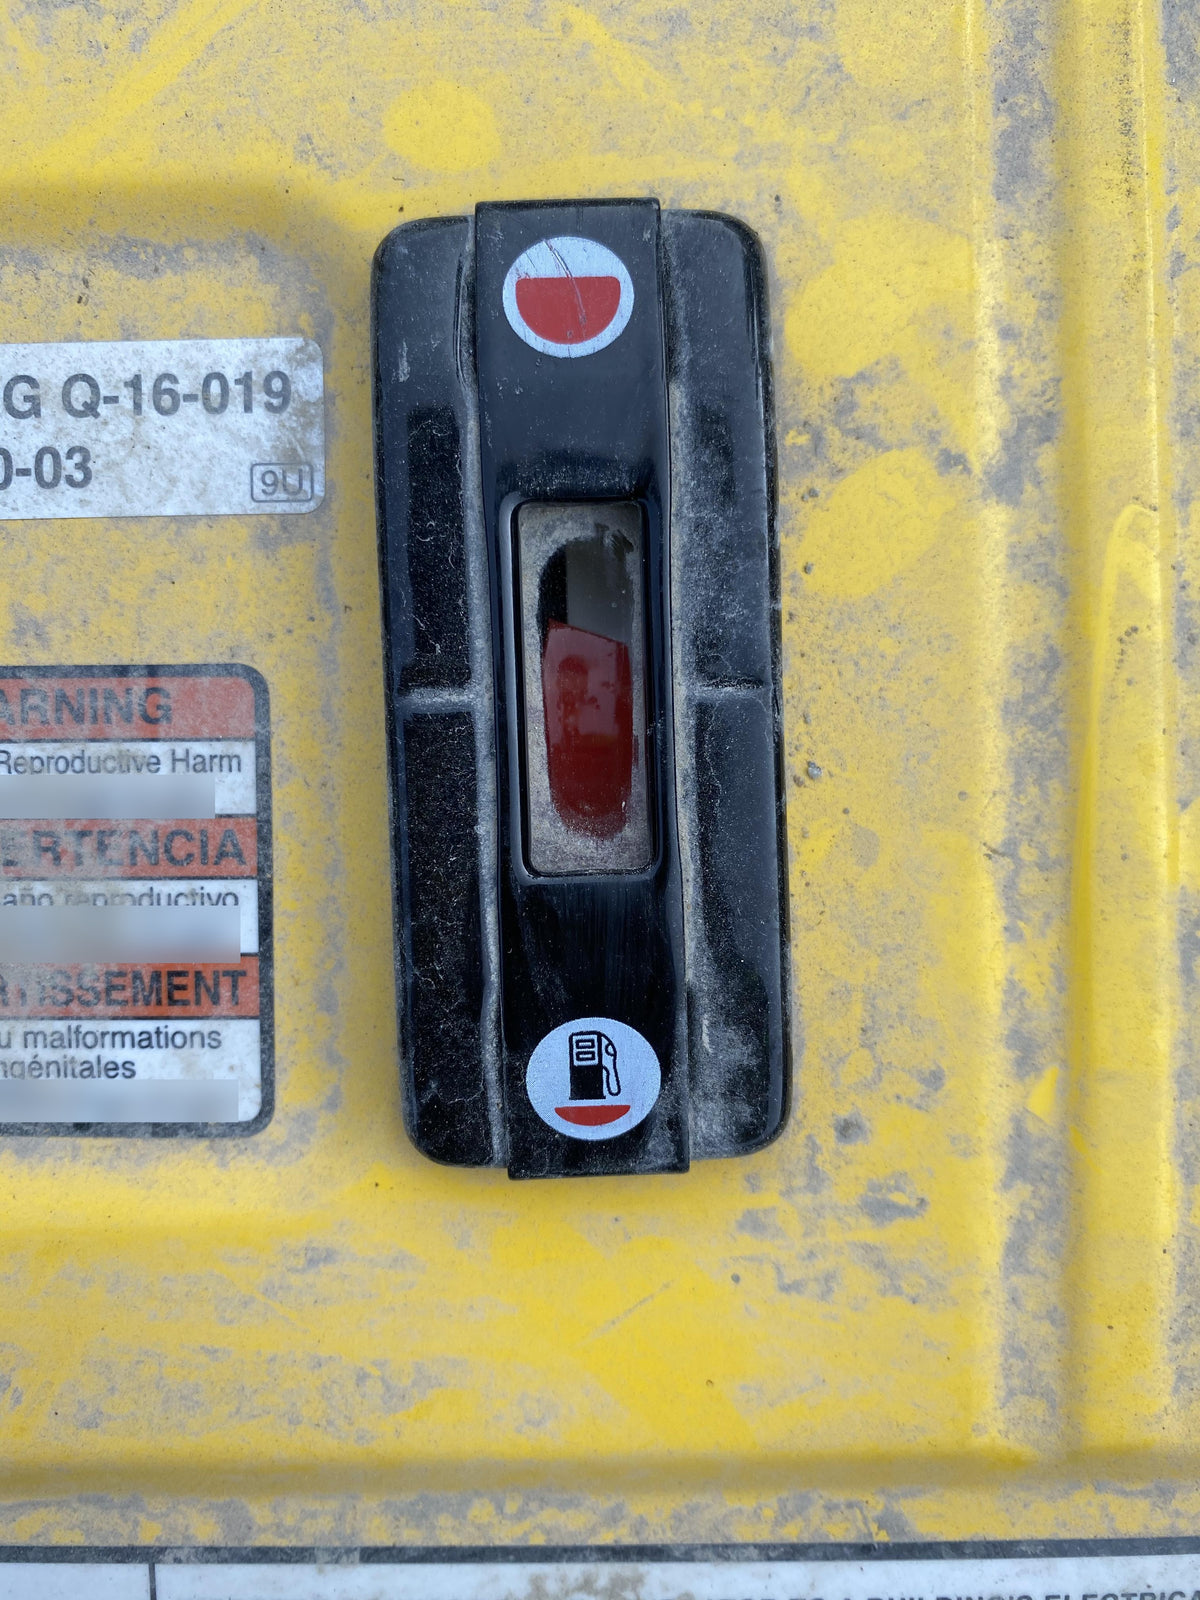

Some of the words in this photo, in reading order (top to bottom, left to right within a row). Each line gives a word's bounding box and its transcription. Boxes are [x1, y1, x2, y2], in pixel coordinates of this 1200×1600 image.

[2, 374, 42, 419] G
[61, 370, 292, 419] Q-16-019
[261, 468, 304, 496] 9U
[0, 748, 161, 775] Reproductive
[171, 748, 241, 774] Harm
[24, 1024, 222, 1050] malformations
